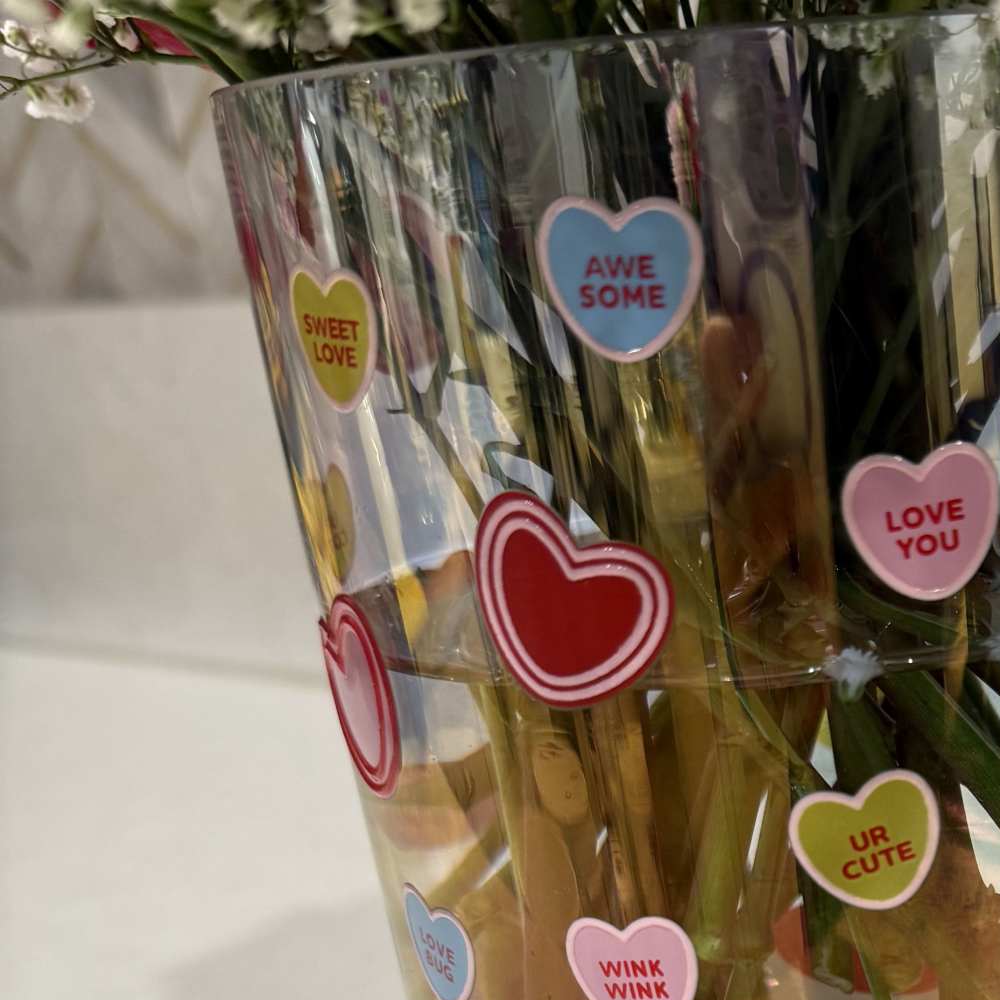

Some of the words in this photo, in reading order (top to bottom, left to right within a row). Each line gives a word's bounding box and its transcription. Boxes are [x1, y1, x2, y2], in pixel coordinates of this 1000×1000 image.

[585, 255, 655, 281] AWE
[579, 284, 666, 310] SOME
[303, 313, 359, 342] SWEET
[313, 341, 357, 368] LOVE
[885, 498, 965, 533] LOVE
[896, 529, 960, 560] YOU
[849, 825, 889, 853] UR
[841, 841, 916, 881] CUTE
[420, 927, 455, 967] LOVE
[425, 949, 454, 983] BUG
[599, 959, 665, 978] WINK
[604, 981, 670, 1000] WINK
